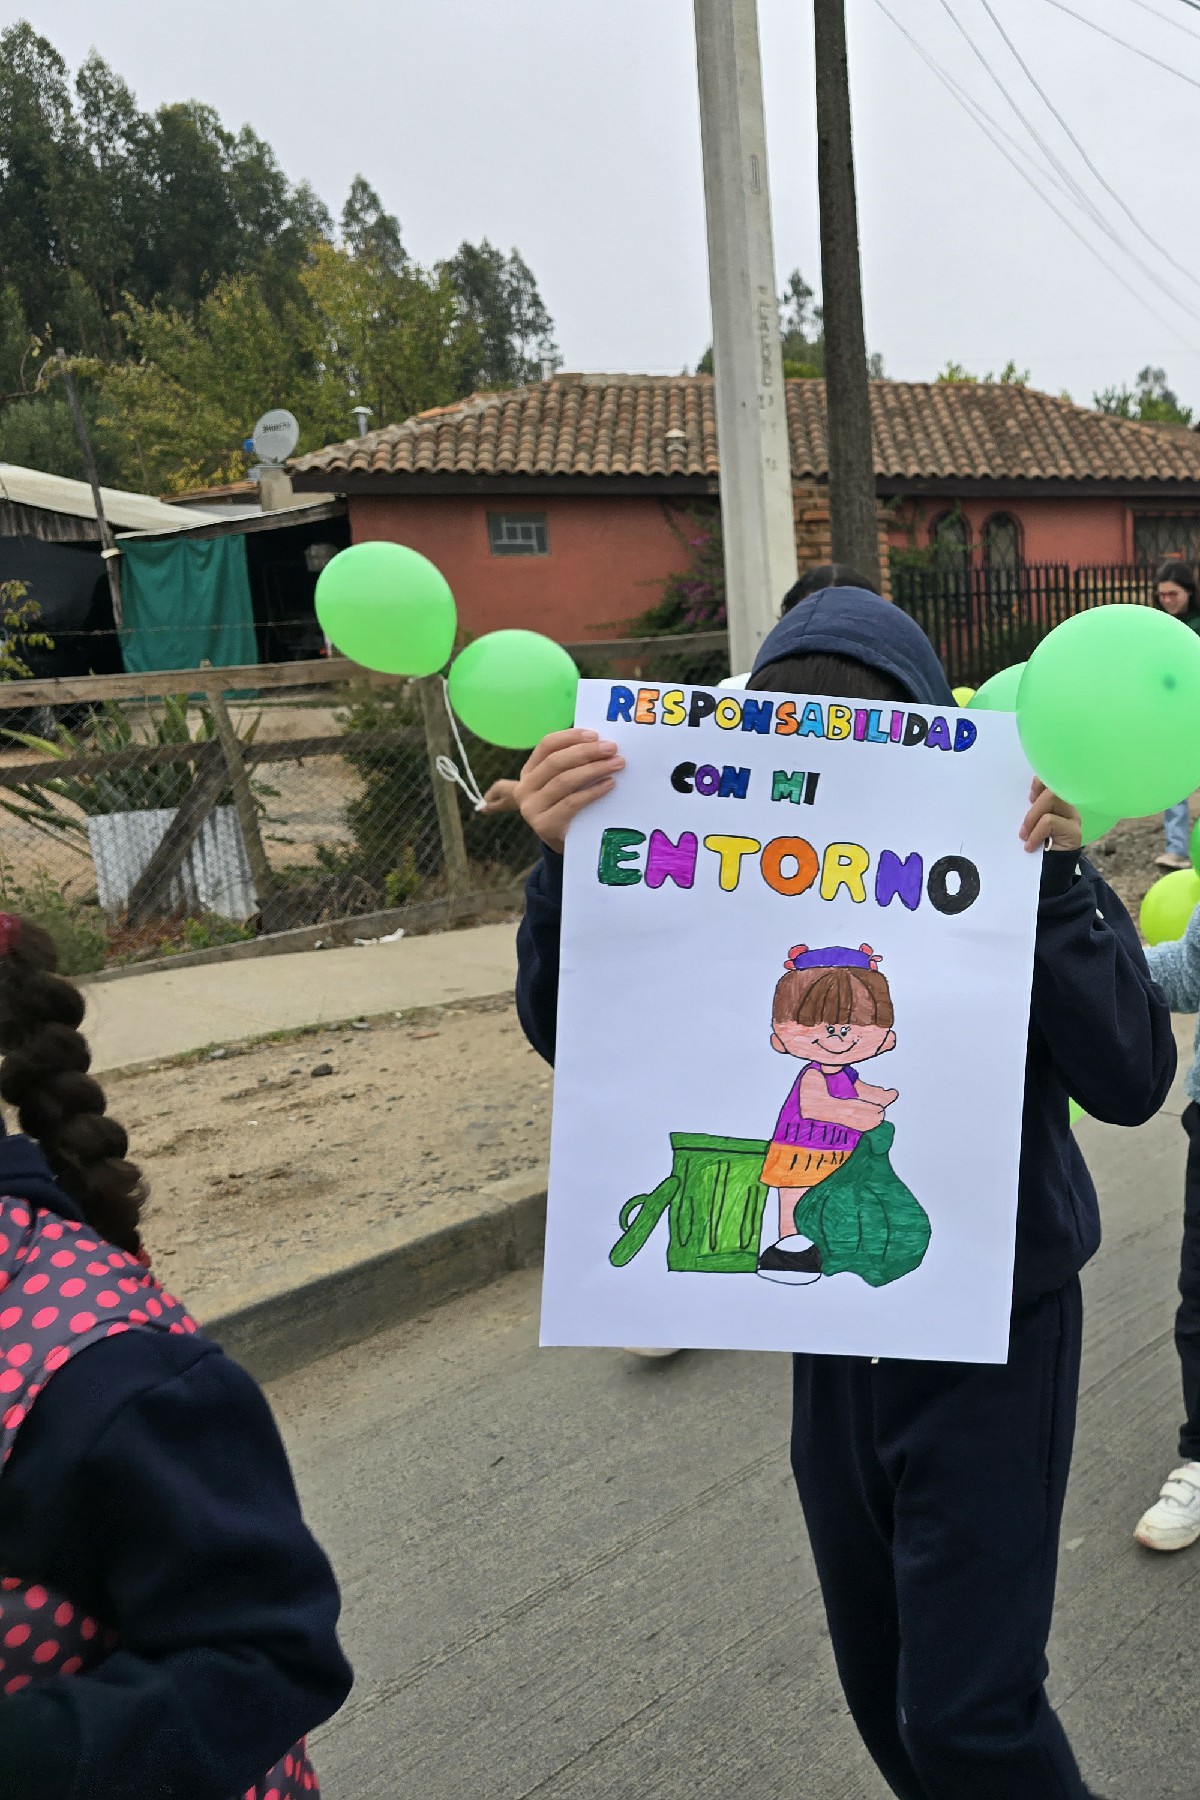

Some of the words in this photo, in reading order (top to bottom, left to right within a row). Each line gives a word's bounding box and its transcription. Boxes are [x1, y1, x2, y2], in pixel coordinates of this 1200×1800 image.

[606, 686, 978, 752] RESPONSABILIDAD
[671, 761, 751, 799] CON
[771, 770, 820, 805] MI
[598, 828, 980, 915] ENTORNO
